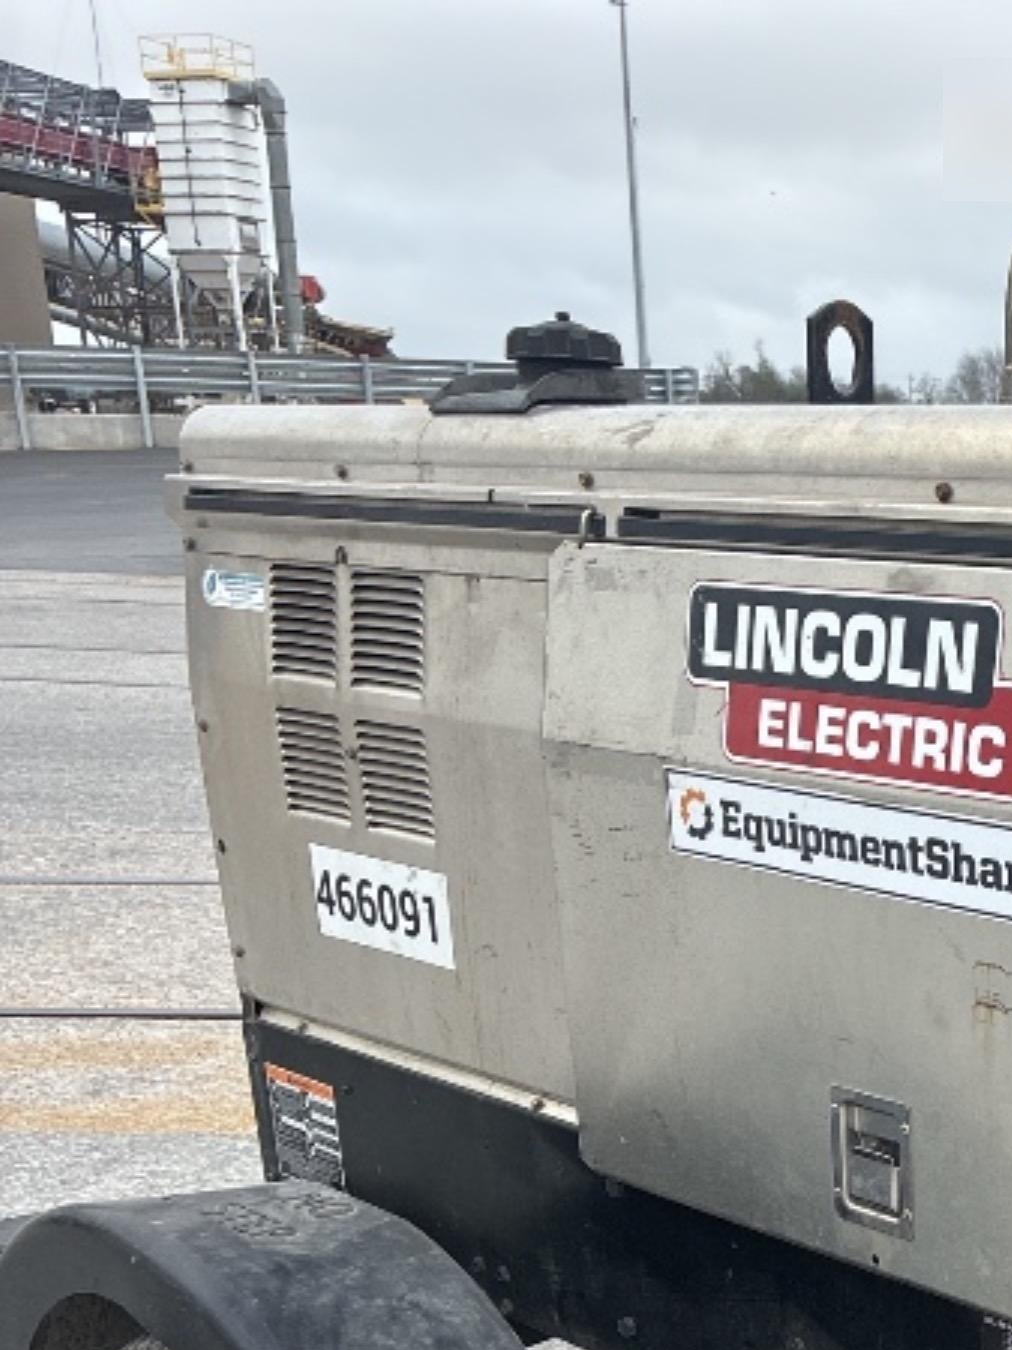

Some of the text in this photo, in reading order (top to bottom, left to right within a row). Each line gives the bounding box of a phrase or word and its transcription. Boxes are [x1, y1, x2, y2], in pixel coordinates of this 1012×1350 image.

[702, 602, 980, 694] LINCOLN
[757, 698, 1006, 779] ELECTRIC
[316, 869, 439, 944] 466091
